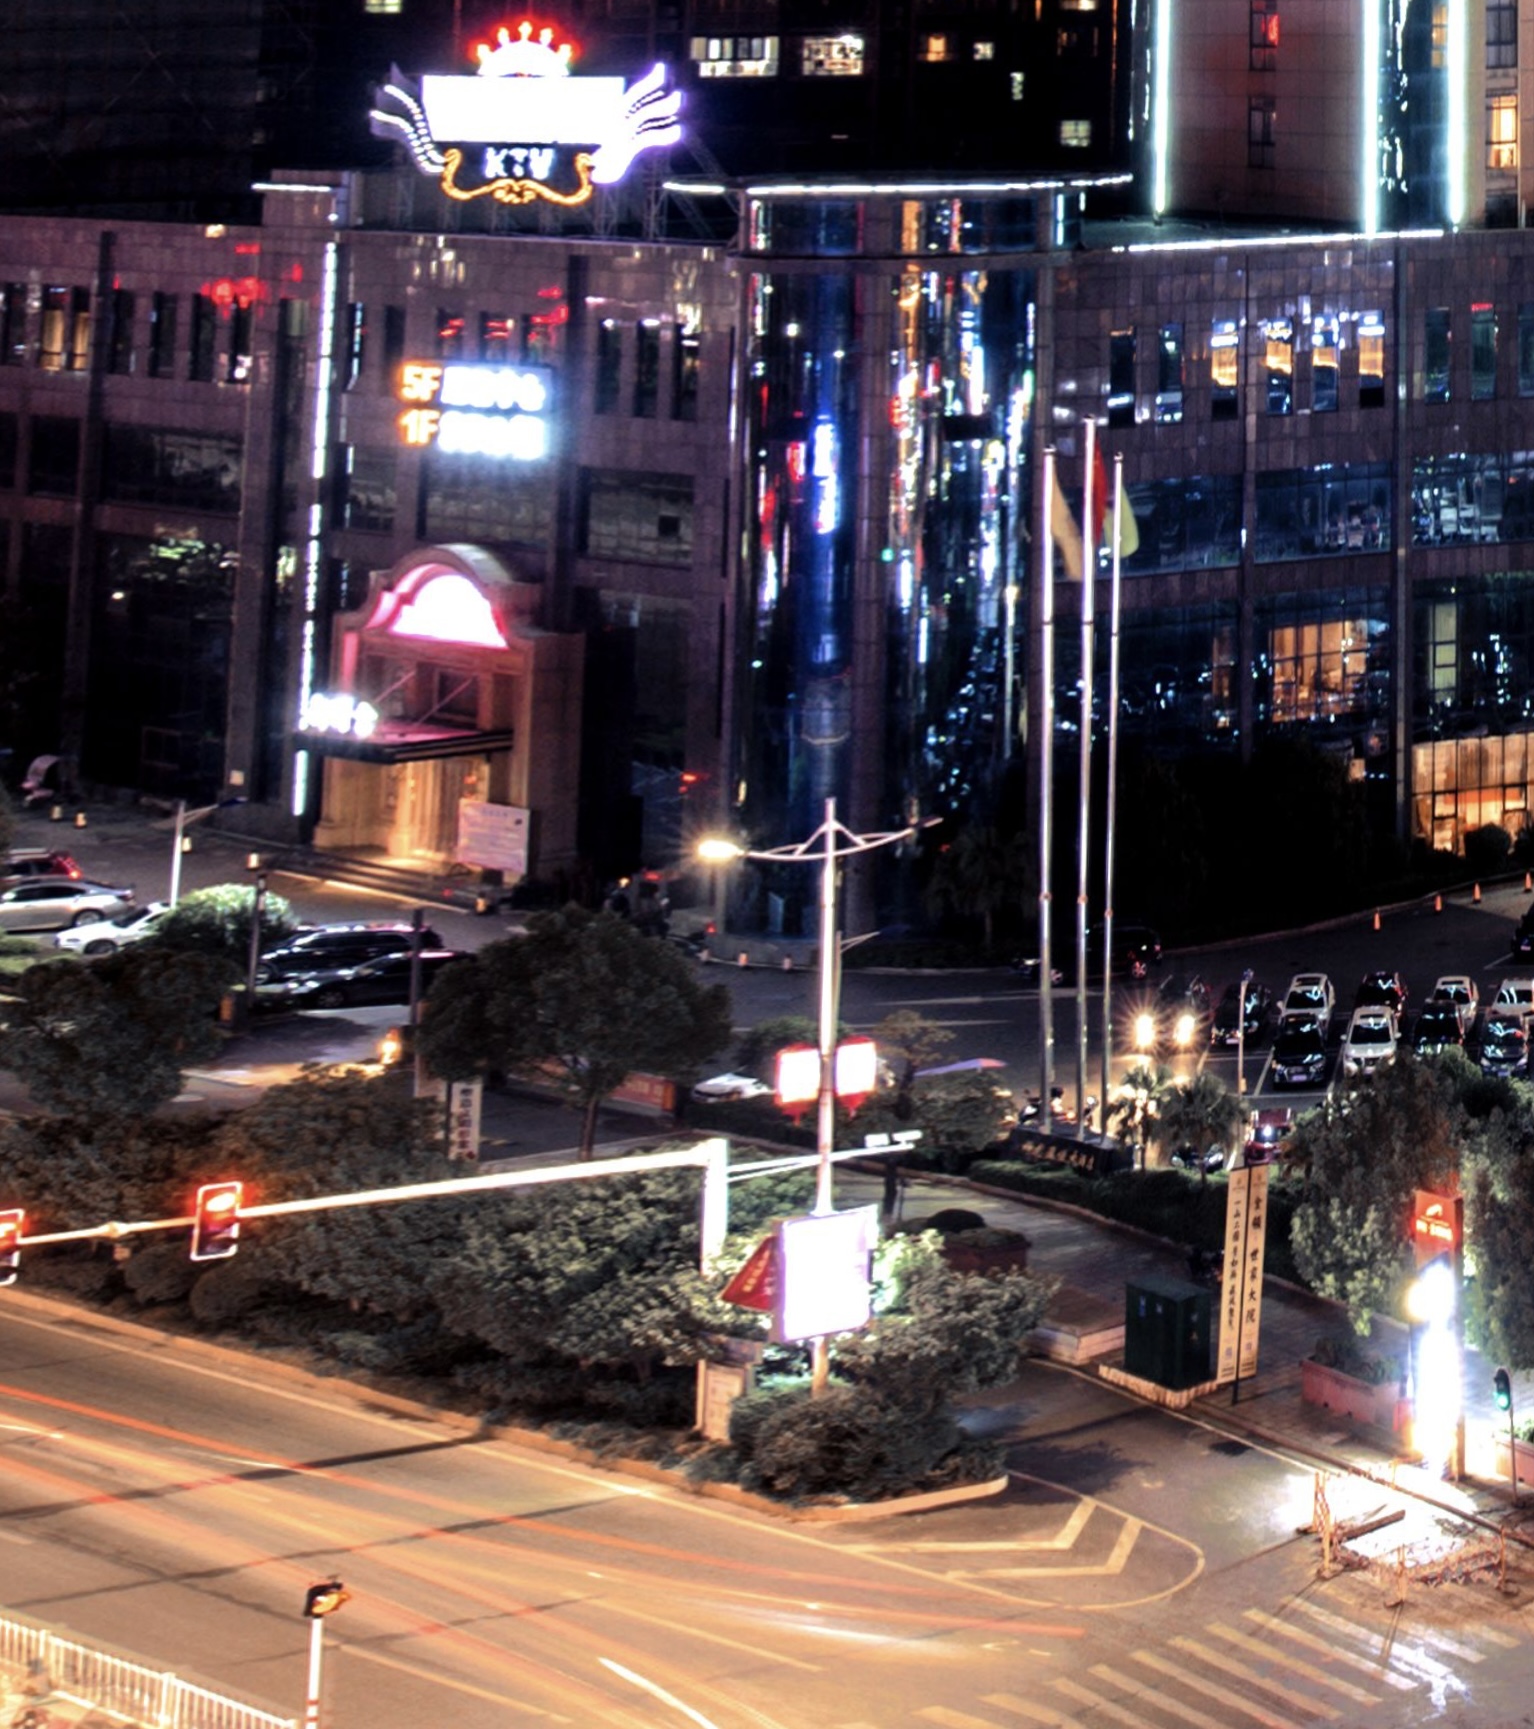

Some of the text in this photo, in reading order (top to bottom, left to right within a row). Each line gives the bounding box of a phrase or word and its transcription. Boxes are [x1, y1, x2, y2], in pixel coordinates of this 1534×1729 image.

[484, 147, 554, 180] KTV
[402, 364, 442, 402] 5F
[400, 408, 440, 445] 1F
